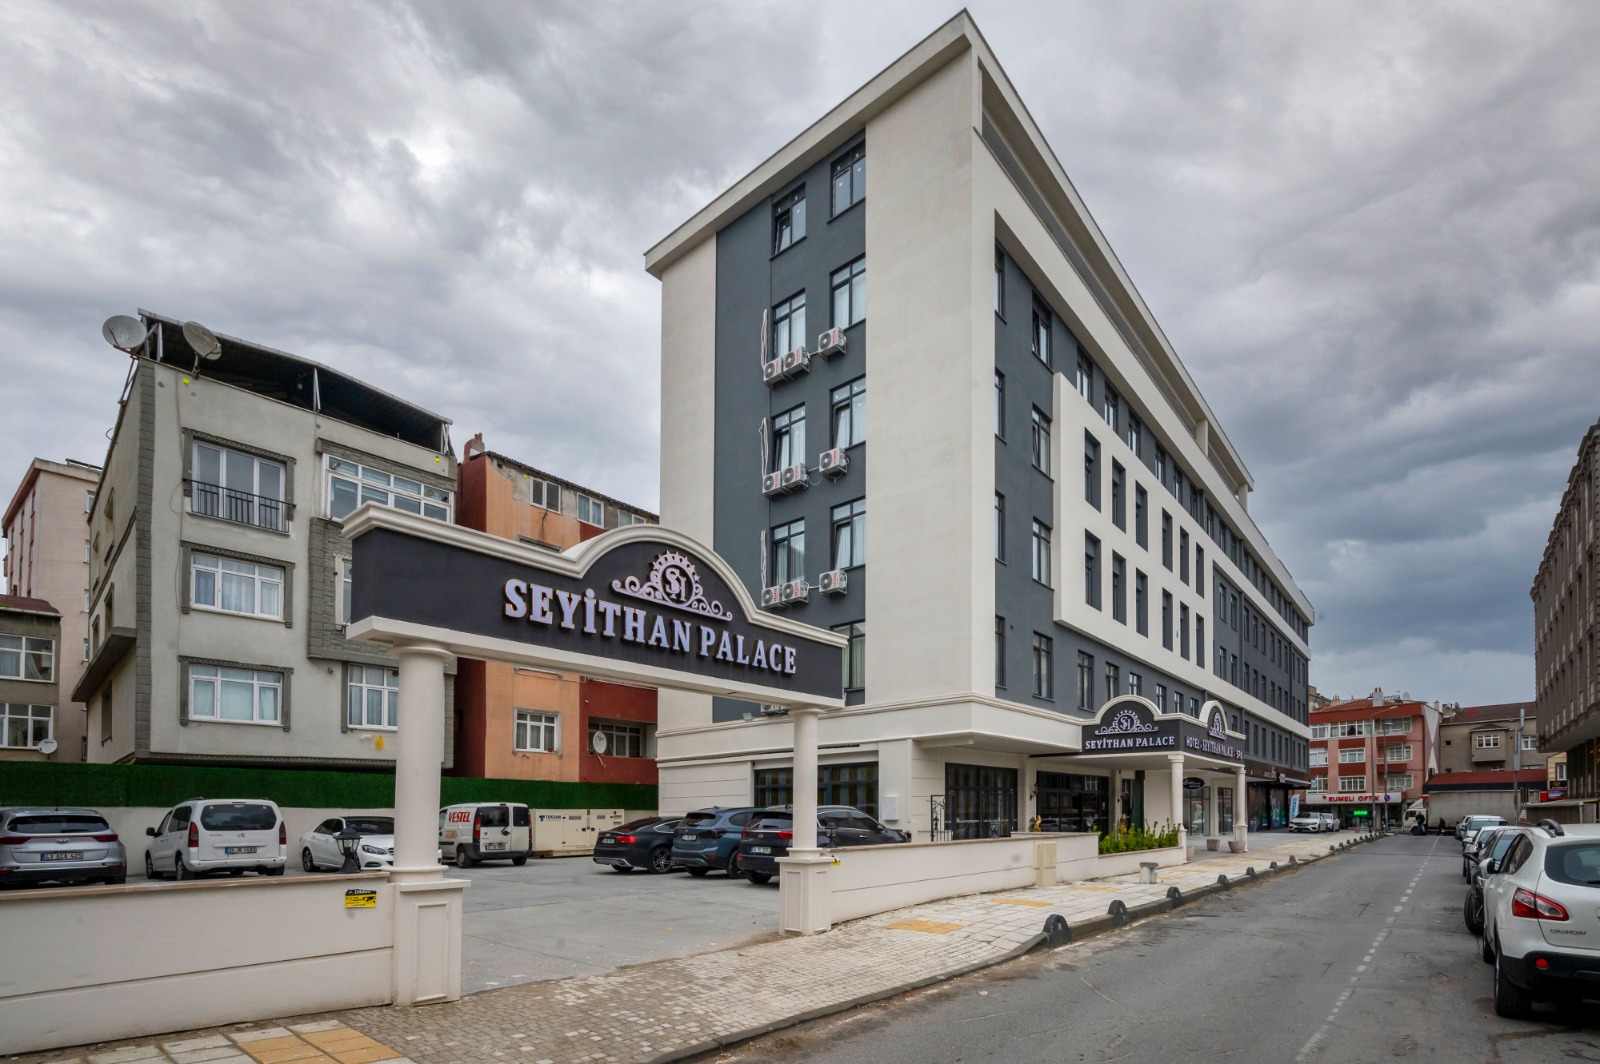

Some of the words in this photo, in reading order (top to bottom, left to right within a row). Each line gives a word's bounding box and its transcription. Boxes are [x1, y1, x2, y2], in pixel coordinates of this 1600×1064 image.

[505, 578, 693, 653] SEYİTHAN
[700, 625, 797, 674] PALACE
[1086, 737, 1133, 749] SEYİTHAN
[1136, 736, 1174, 747] PALACE
[448, 811, 471, 822] VESTEL
